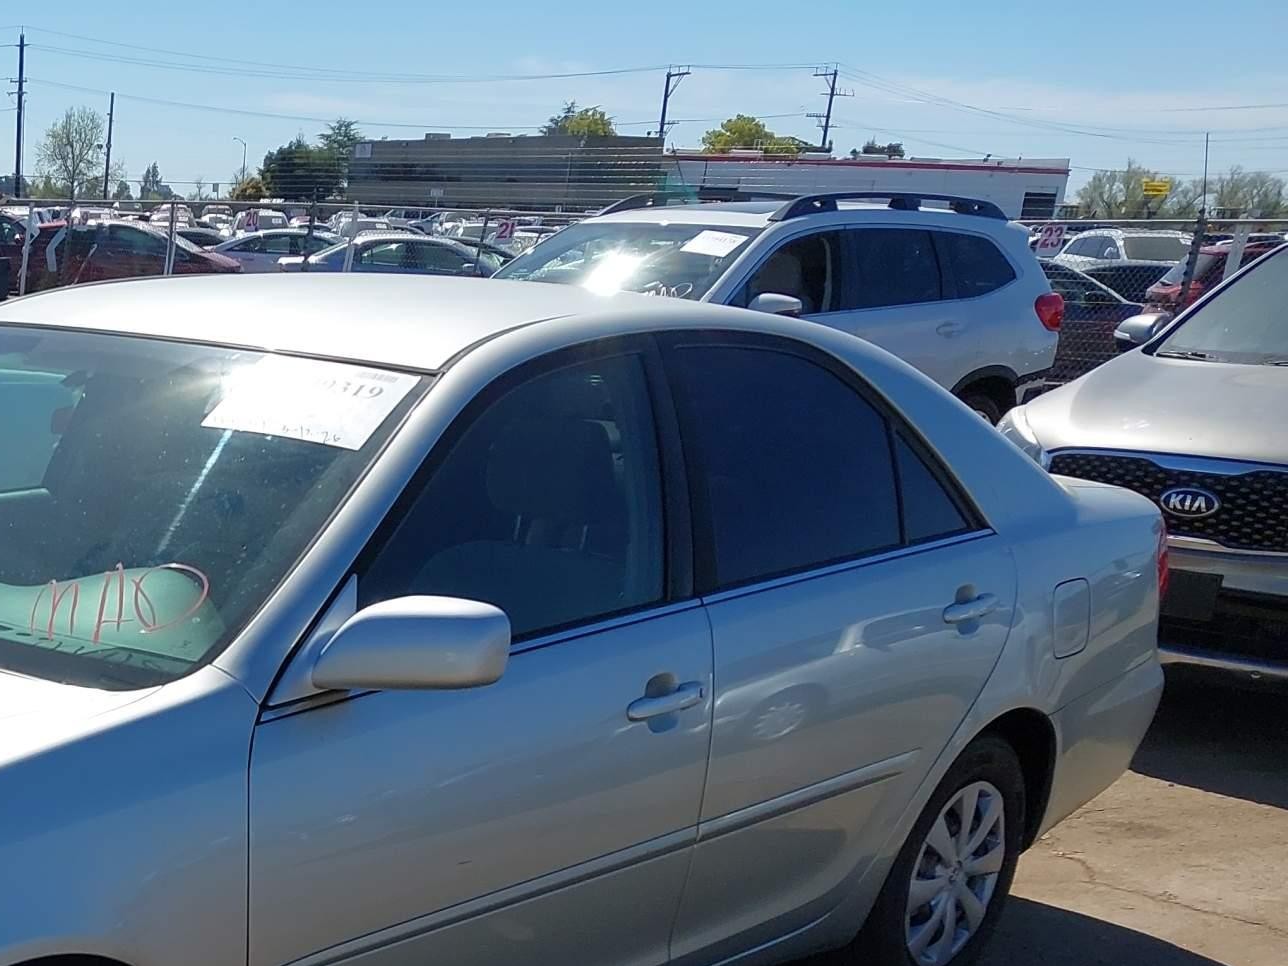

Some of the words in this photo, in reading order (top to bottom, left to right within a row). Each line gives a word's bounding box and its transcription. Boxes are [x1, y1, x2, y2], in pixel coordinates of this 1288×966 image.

[245, 211, 258, 227] 20
[496, 222, 515, 239] 21
[1039, 226, 1064, 248] 23
[1168, 493, 1207, 513] KIA
